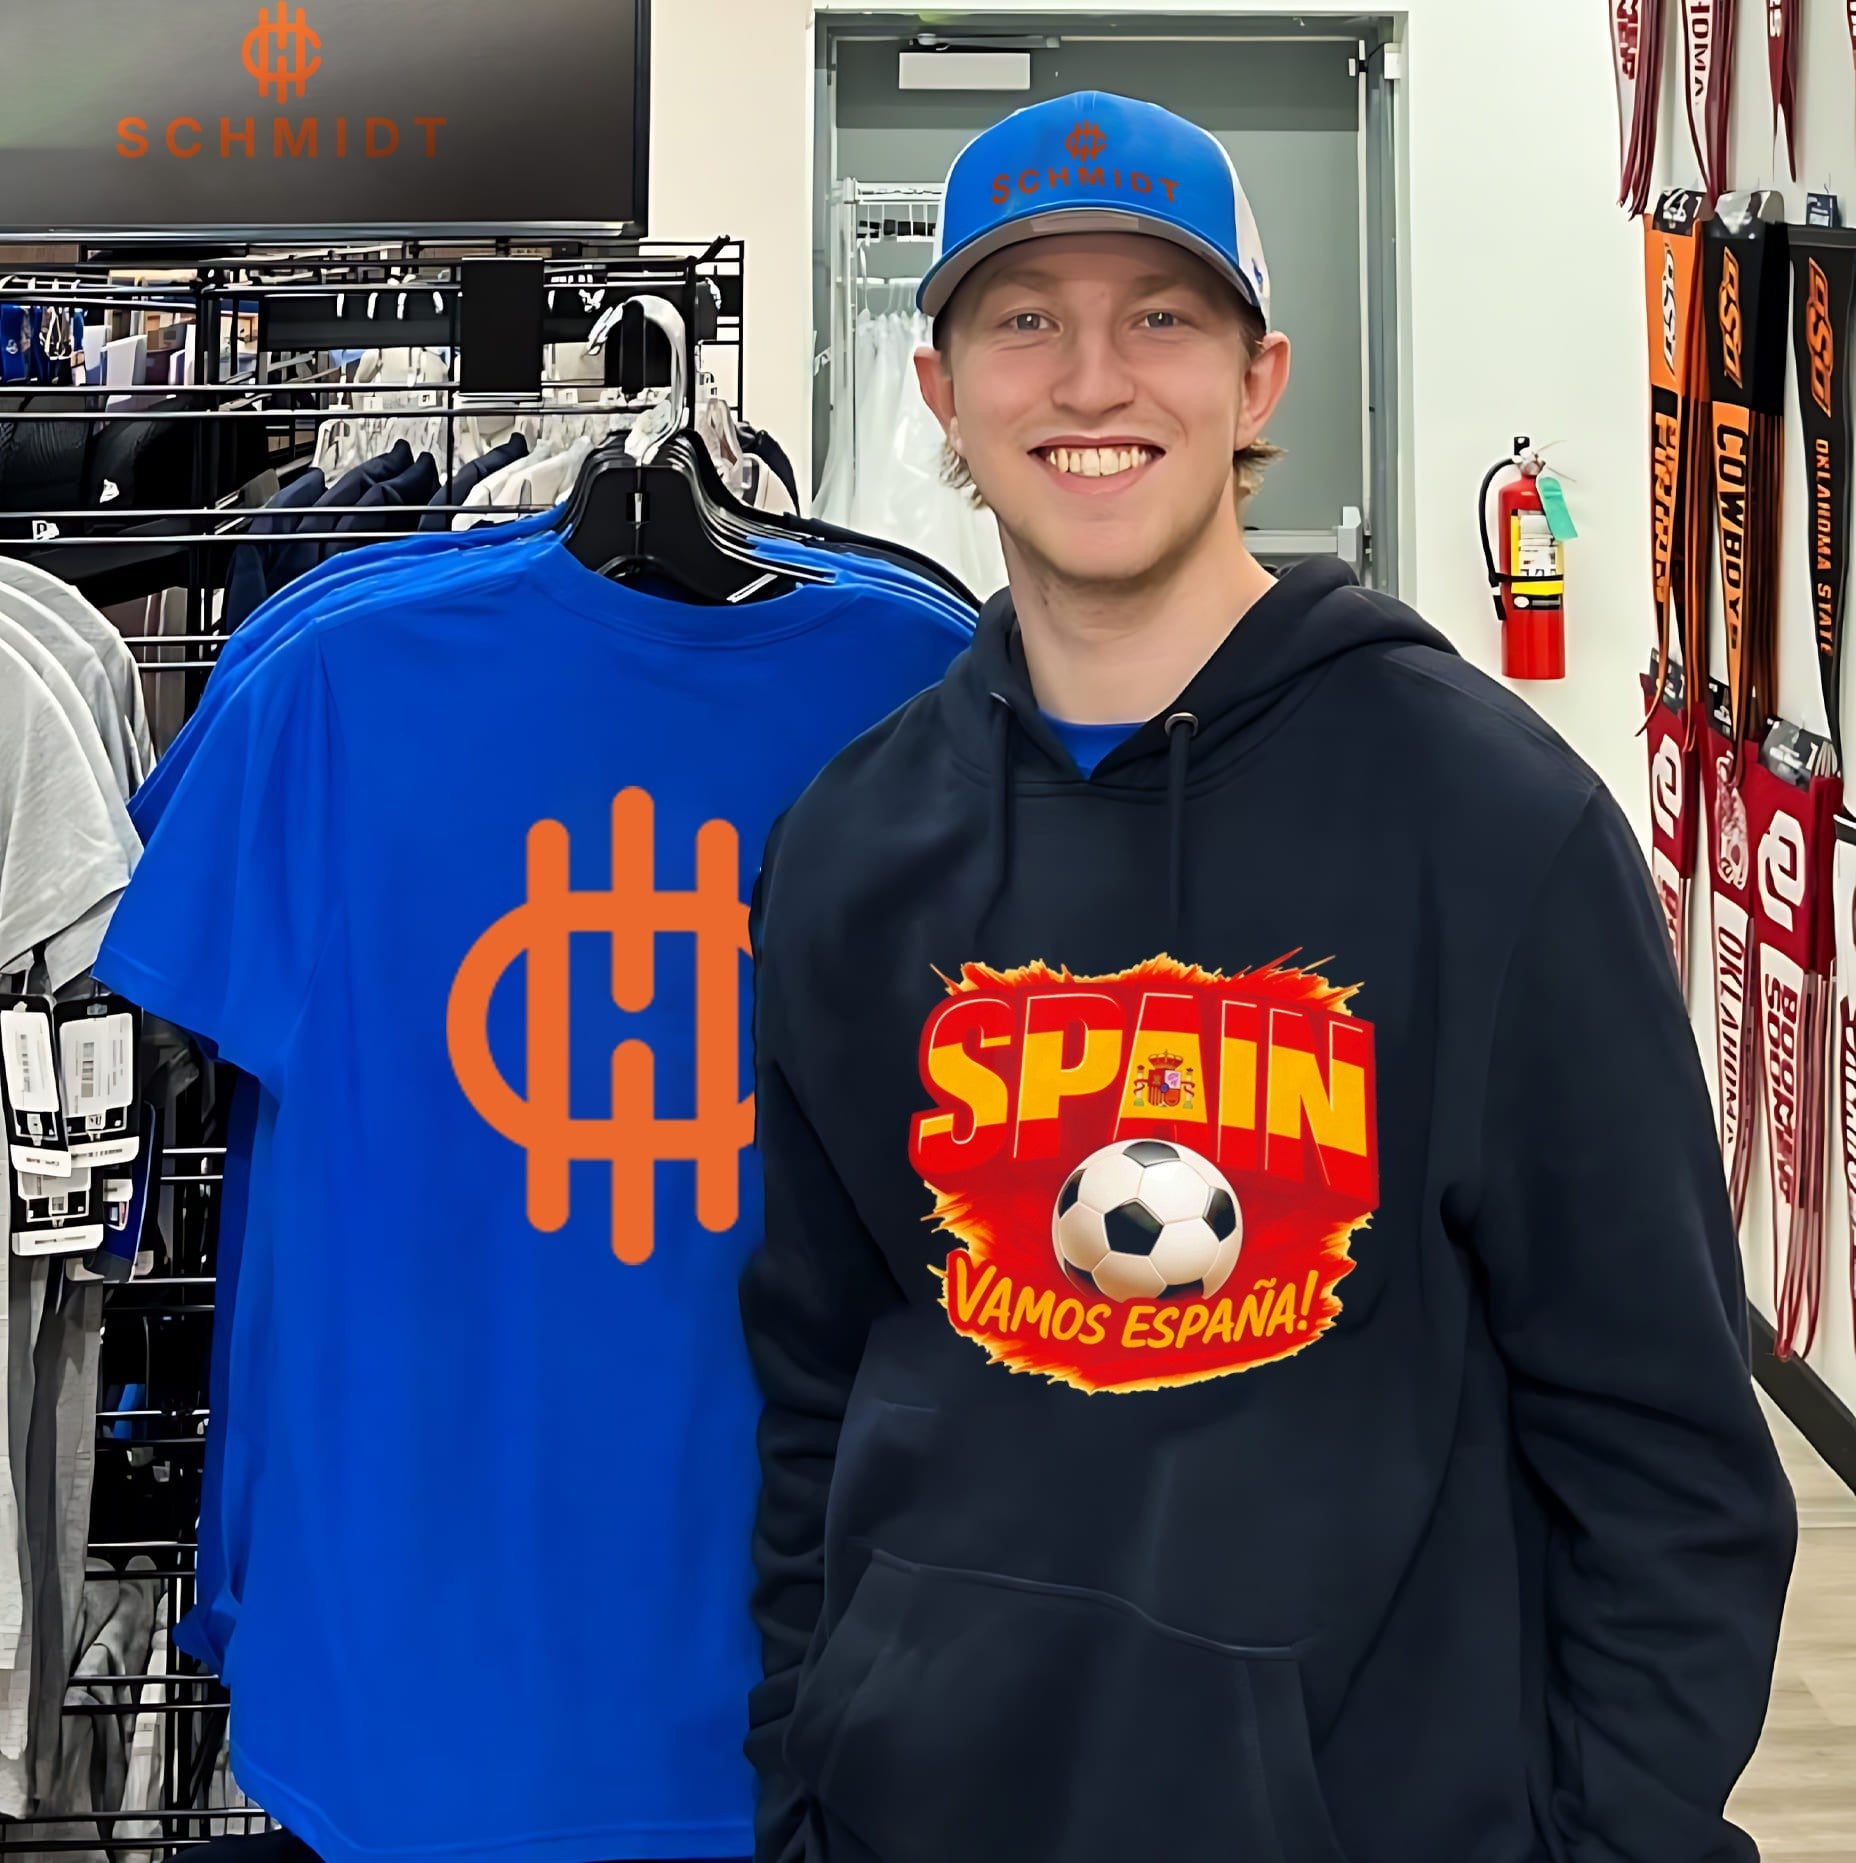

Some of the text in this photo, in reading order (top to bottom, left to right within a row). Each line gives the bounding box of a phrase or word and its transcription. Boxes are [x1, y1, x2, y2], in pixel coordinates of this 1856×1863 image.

[116, 116, 448, 159] SCHMIDT
[991, 166, 1180, 205] SCHMIDT
[1717, 925, 1745, 1144] OKLAHOMA
[913, 990, 1376, 1205] SPAIN
[954, 1251, 1319, 1349] VAMOS ESPAÑA!
